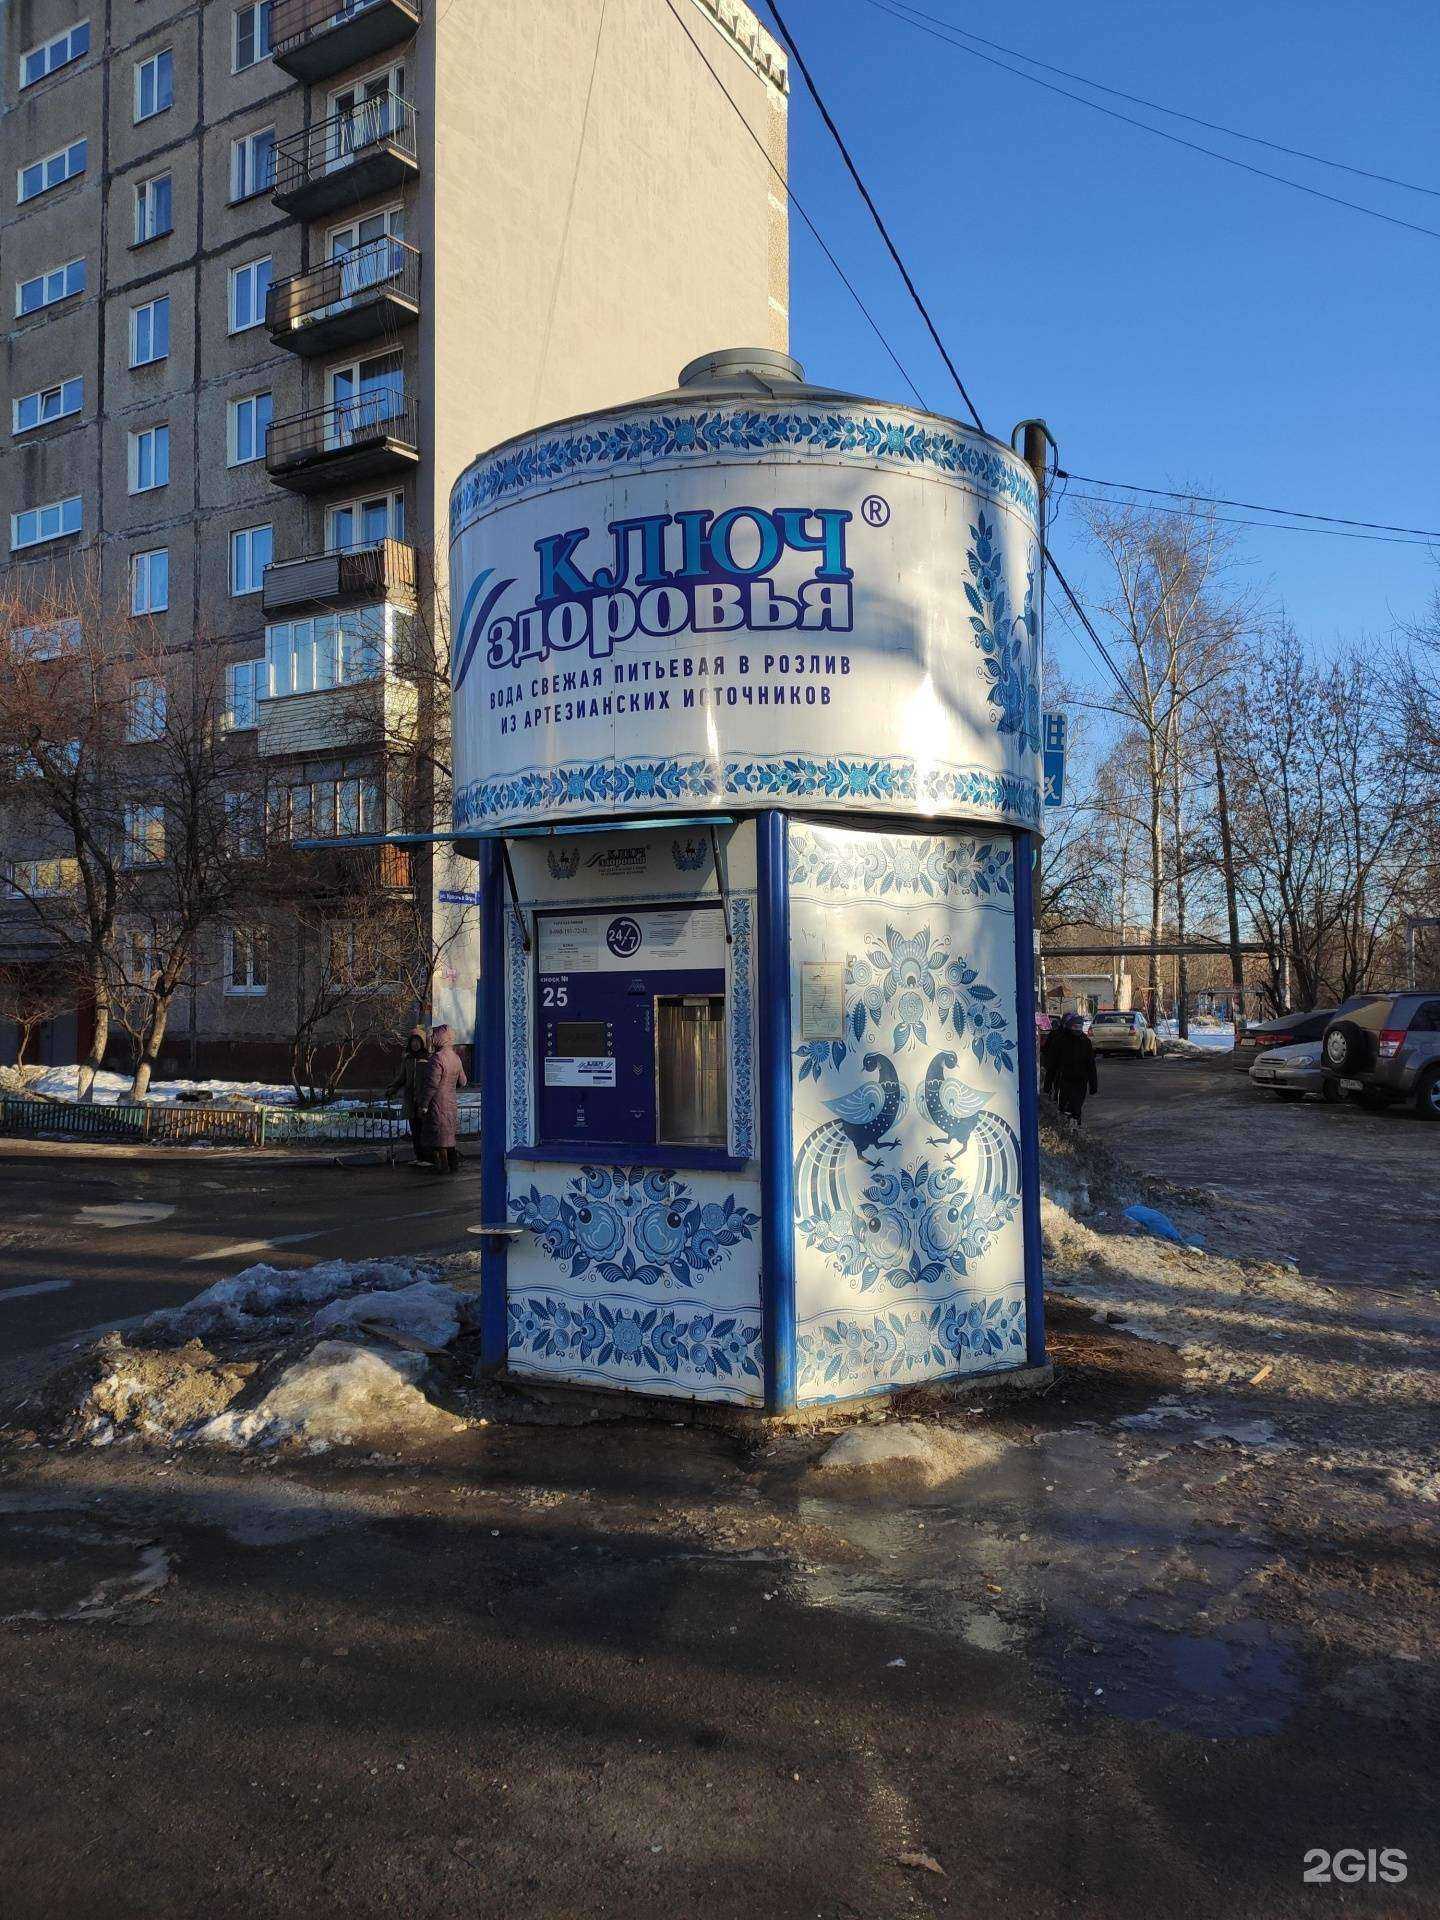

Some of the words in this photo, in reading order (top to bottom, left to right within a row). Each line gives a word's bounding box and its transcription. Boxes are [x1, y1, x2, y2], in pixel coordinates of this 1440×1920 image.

[534, 506, 854, 604] КЛЮЧ
[490, 684, 523, 710] ВОДА
[531, 667, 602, 698] СВЕЖАЯ
[614, 656, 725, 684] ПИТЬЕВАЯ
[739, 655, 750, 674] В
[764, 654, 851, 675] РОЗЛИВ
[501, 715, 517, 736] ИЗ
[524, 690, 670, 729] АРТЕЗИАНСКИХ
[683, 685, 831, 708] ИСТОЧНИКОВ
[543, 987, 569, 1007] 25
